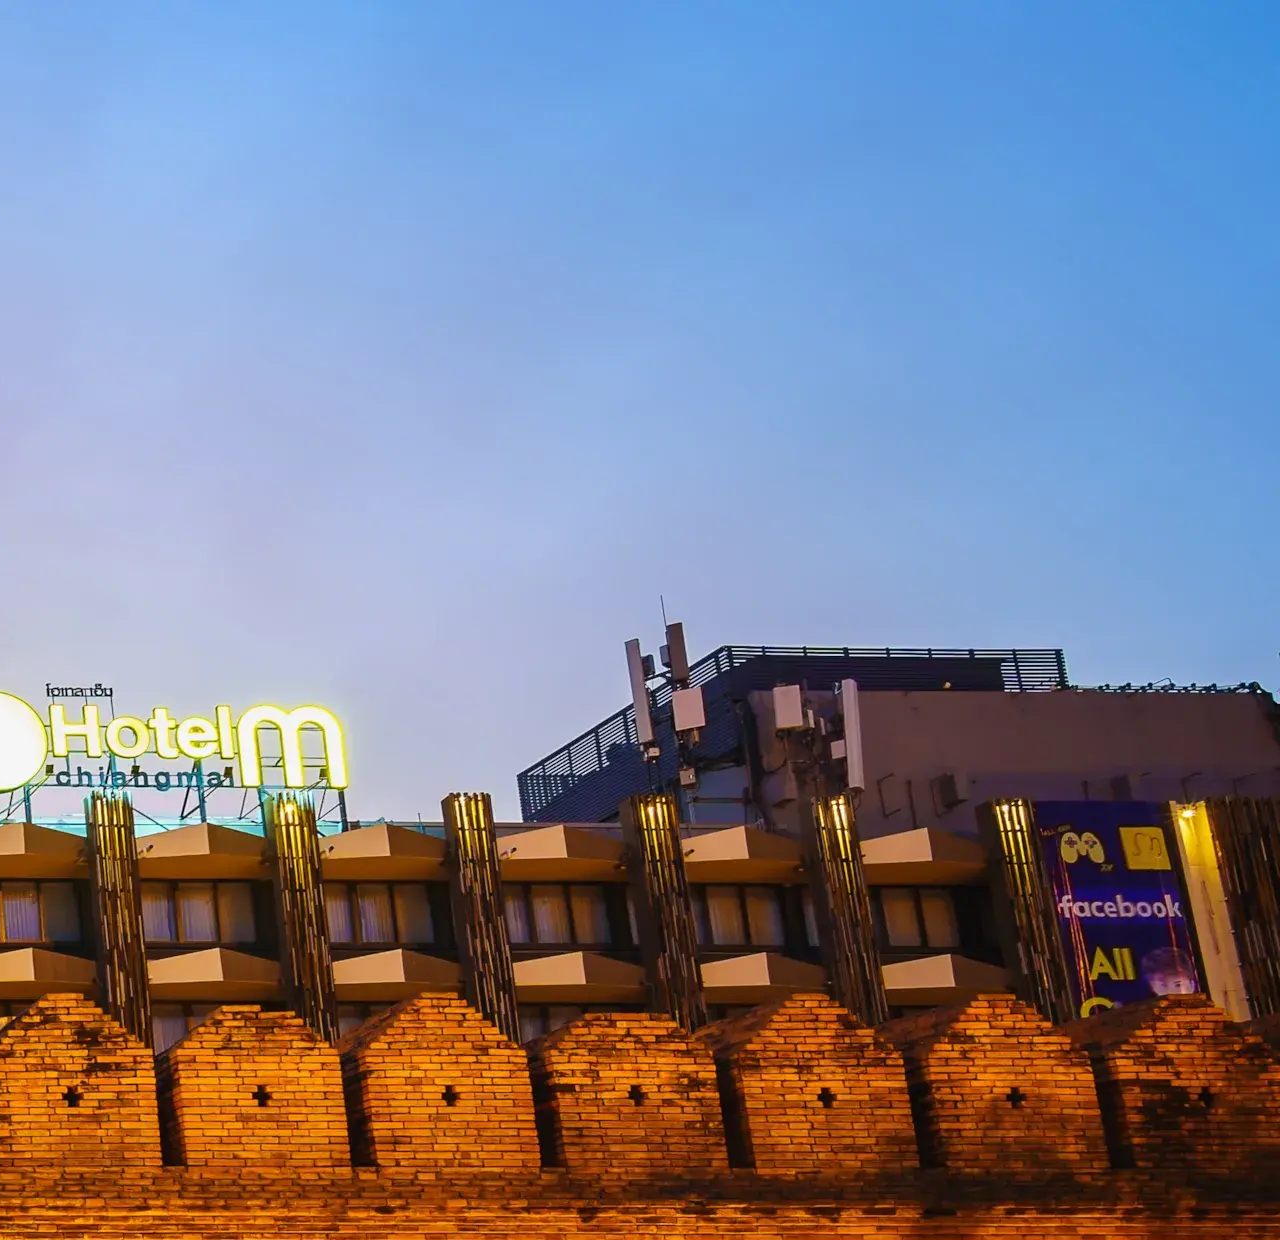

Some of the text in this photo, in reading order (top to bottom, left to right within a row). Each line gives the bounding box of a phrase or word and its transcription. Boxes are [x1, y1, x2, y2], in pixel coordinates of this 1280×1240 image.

[48, 704, 236, 759] Hotel
[1059, 894, 1182, 918] facebook
[1090, 946, 1136, 980] All
